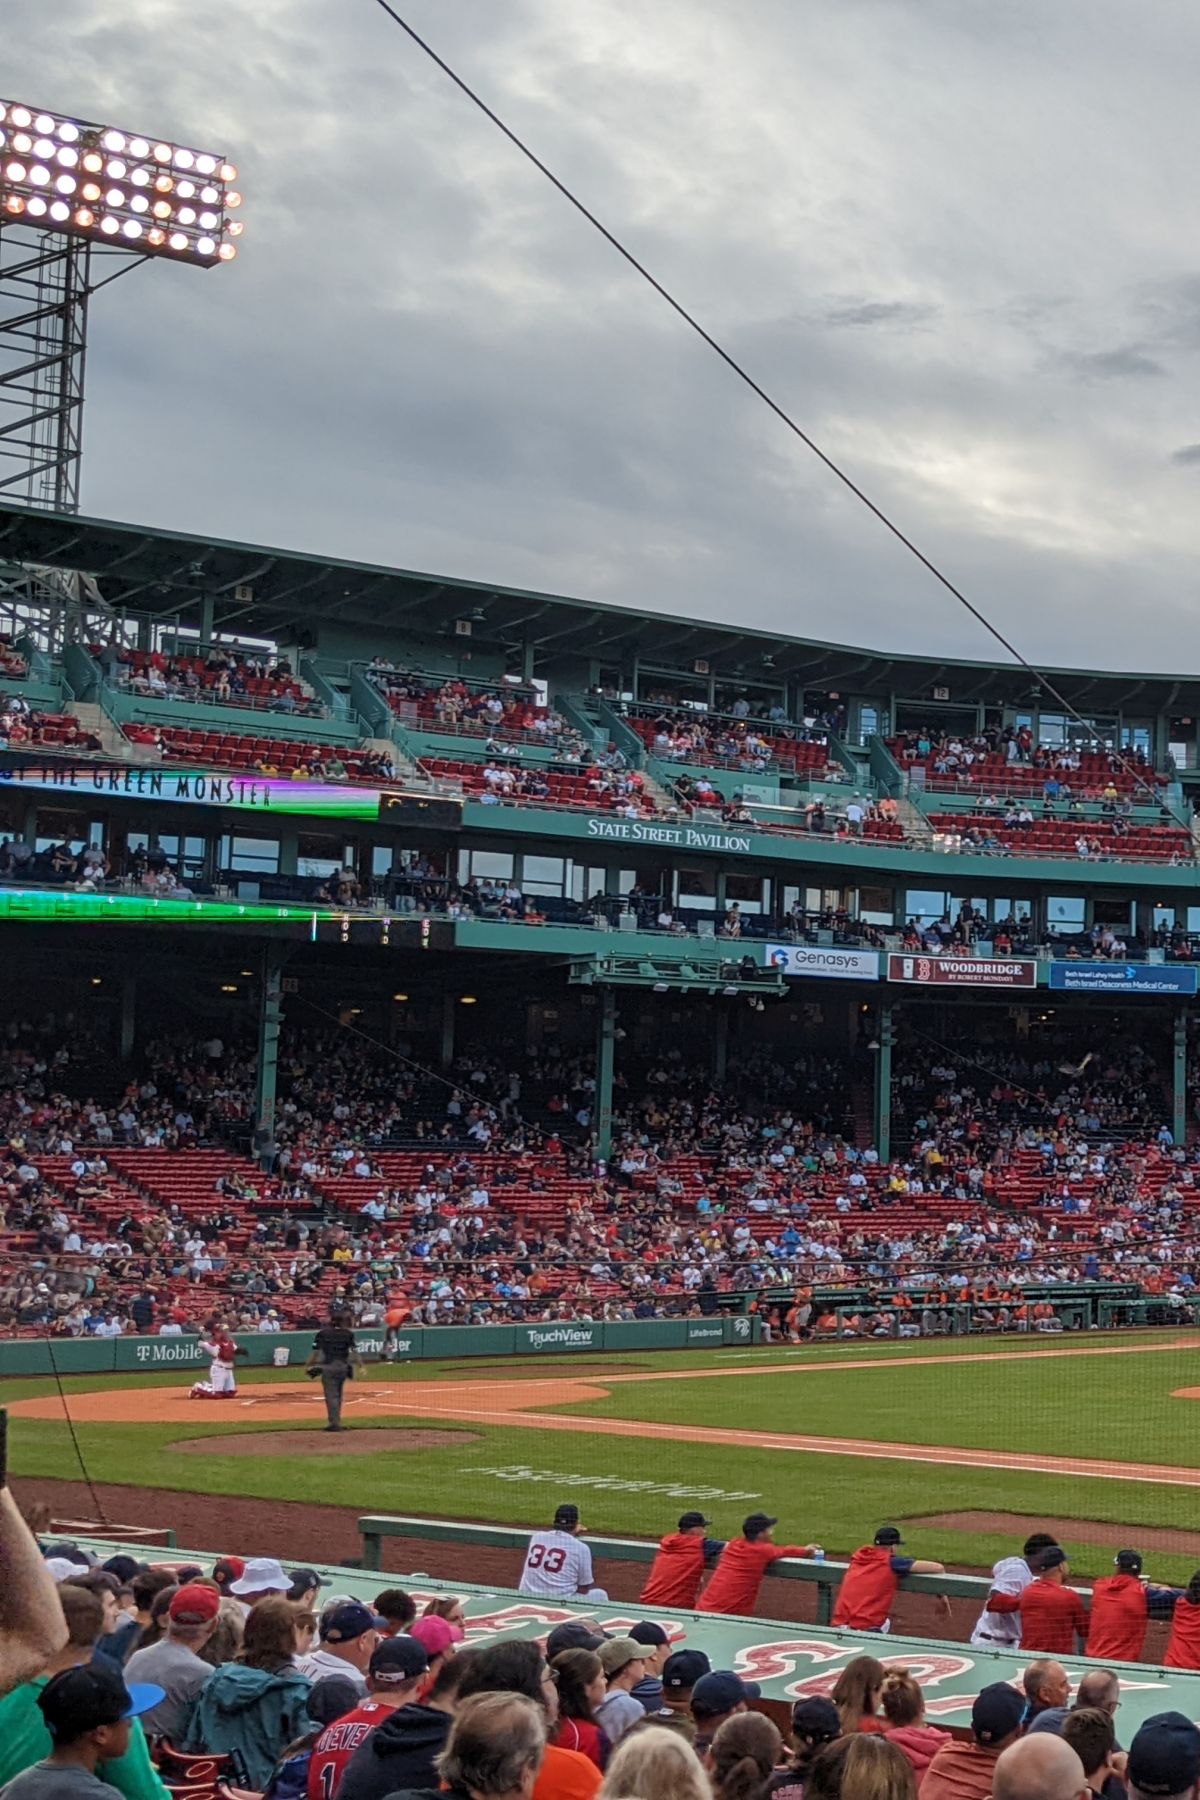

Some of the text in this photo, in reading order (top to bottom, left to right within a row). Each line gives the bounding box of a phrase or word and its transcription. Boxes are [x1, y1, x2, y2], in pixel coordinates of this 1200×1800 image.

[93, 769, 162, 796] GREEN
[175, 775, 272, 807] MONSTER
[588, 819, 751, 852] STATE STREET PAVILION
[795, 950, 860, 968] Genasys
[939, 961, 1022, 975] WOODBRIDGE
[1065, 979, 1179, 990] Beth Israel Deaconess Medical Center
[528, 1329, 592, 1346] TouchView
[528, 1544, 567, 1573] 33
